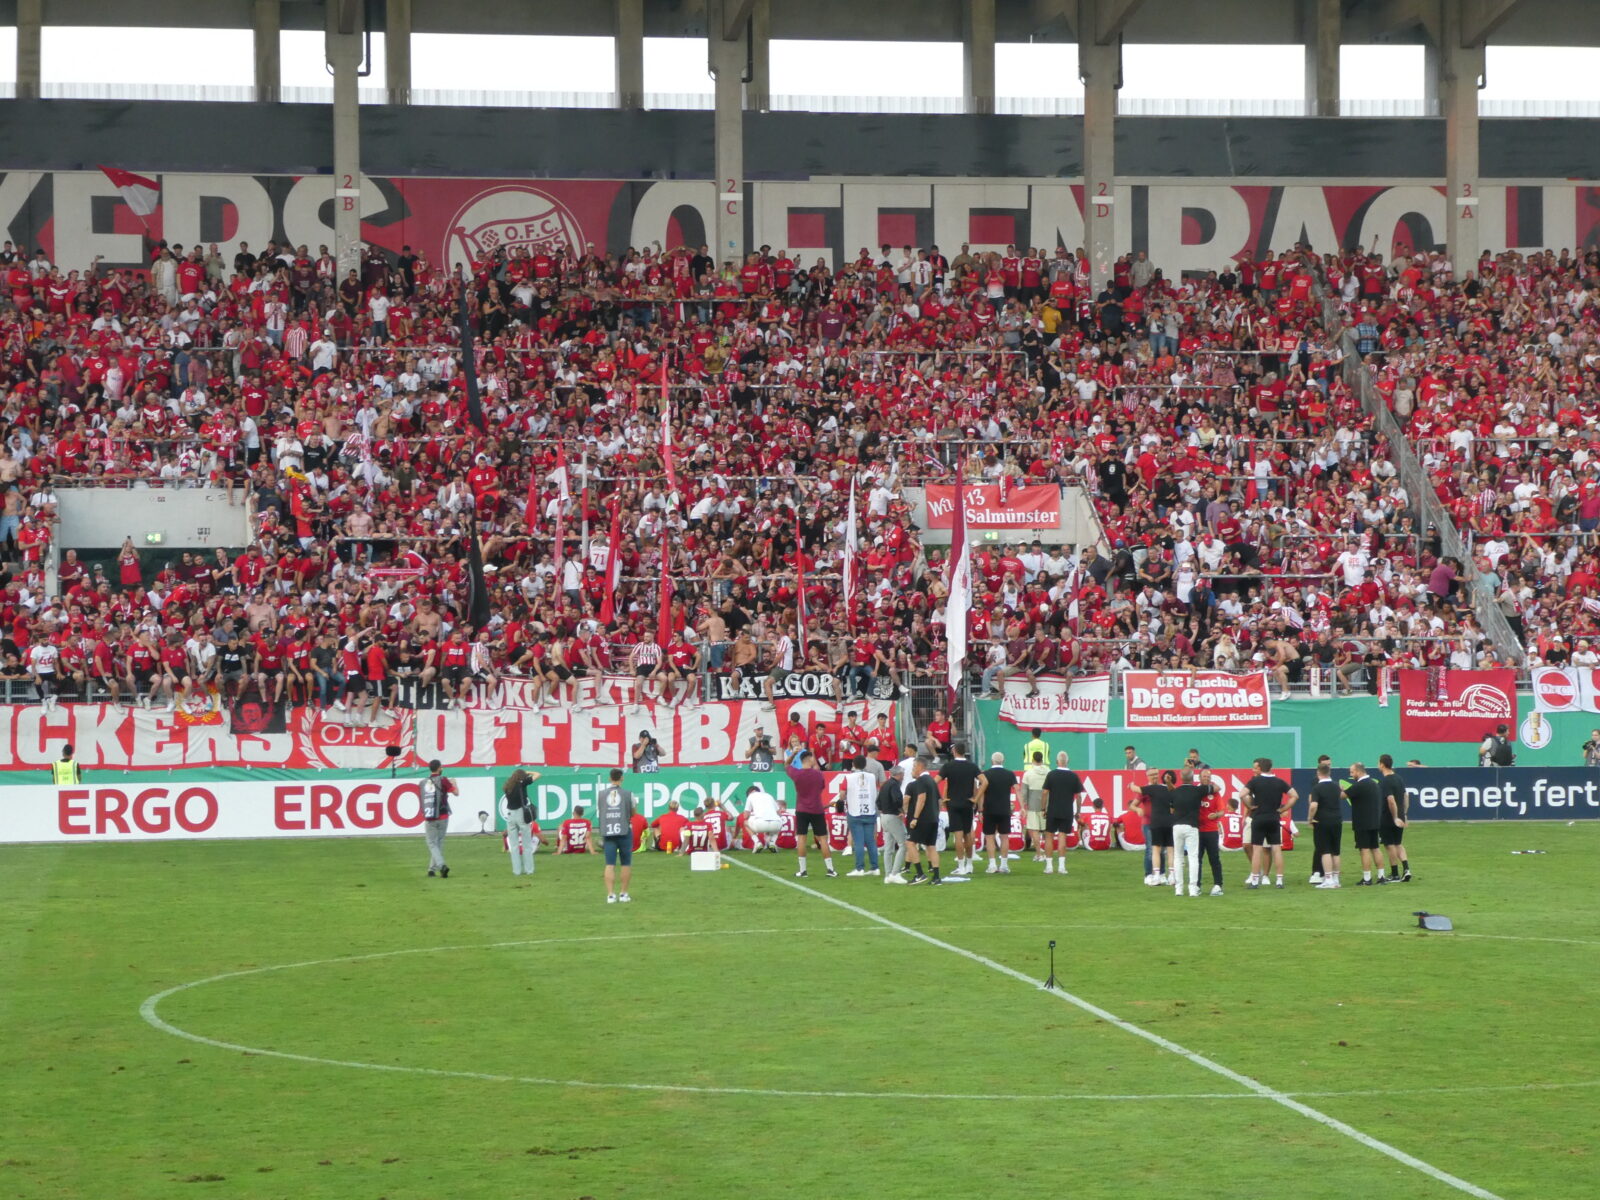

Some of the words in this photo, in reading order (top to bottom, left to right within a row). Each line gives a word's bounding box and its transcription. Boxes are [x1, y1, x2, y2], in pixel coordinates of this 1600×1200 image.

[343, 175, 353, 188] 2
[727, 179, 736, 193] 2
[1098, 182, 1107, 196] 2
[1463, 184, 1471, 197] 3
[343, 197, 354, 211] B
[726, 201, 737, 214] C
[1096, 204, 1109, 217] D
[1461, 205, 1473, 218] A
[504, 219, 559, 242] O.F.C.
[928, 497, 966, 518] Wil
[967, 489, 986, 507] 13
[966, 508, 1058, 523] Salmünster
[593, 554, 605, 565] 71
[721, 673, 864, 699] KATEGORE
[1055, 694, 1106, 715] Power
[1131, 688, 1175, 709] Die
[1181, 688, 1263, 709] Goude
[1130, 714, 1160, 722] Einmal
[1163, 714, 1196, 722] Kickers
[1229, 713, 1263, 721] Kickers
[1406, 709, 1450, 717] Offenbacher
[321, 724, 394, 745] O.F.C.
[1405, 781, 1527, 815] reenet,
[58, 787, 218, 834] ERGO
[274, 783, 426, 830] ERGO
[606, 823, 621, 834] 16
[832, 820, 848, 836] 31
[1091, 819, 1109, 836] 37
[1229, 817, 1240, 832] 6
[569, 828, 587, 845] 32
[692, 830, 707, 847] 17
